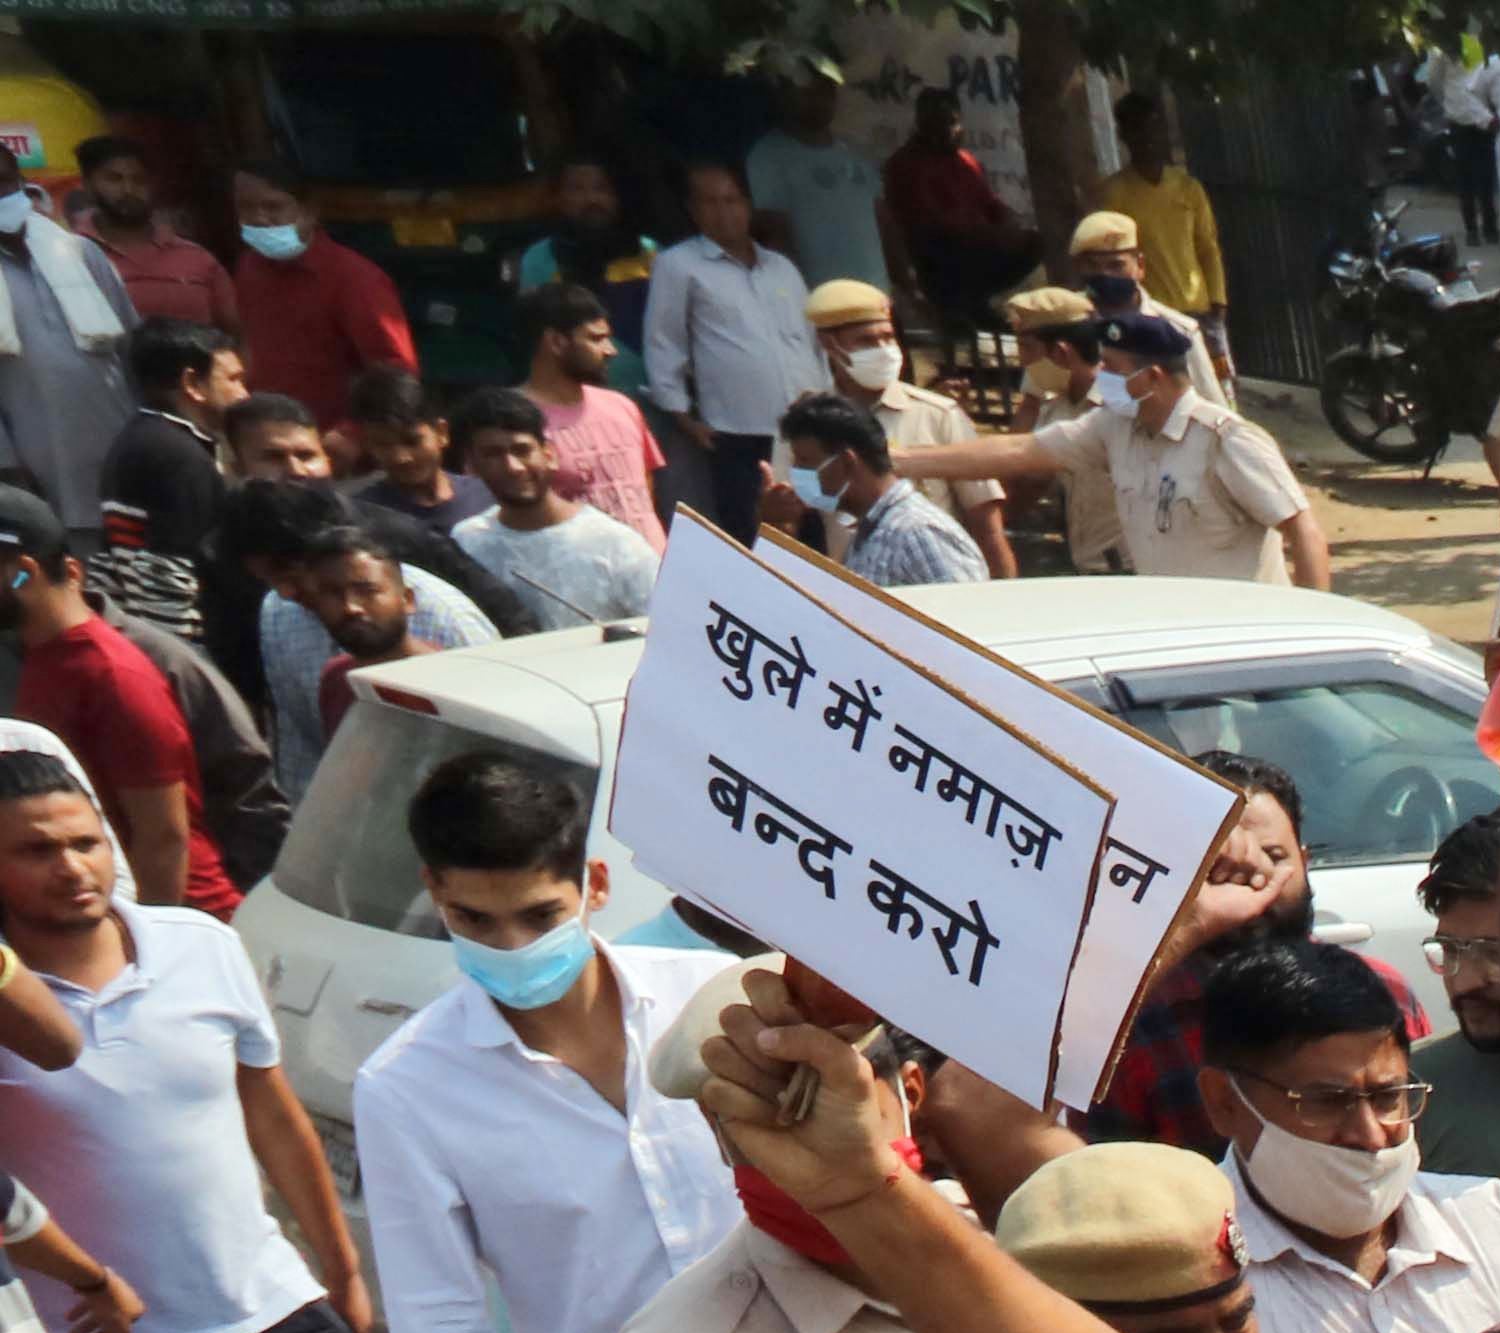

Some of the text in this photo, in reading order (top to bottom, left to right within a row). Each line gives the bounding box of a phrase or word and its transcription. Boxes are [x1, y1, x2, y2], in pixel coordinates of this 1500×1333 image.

[706, 600, 1063, 872] खुले में नमाज़
[707, 754, 1001, 988] बन्द करो
